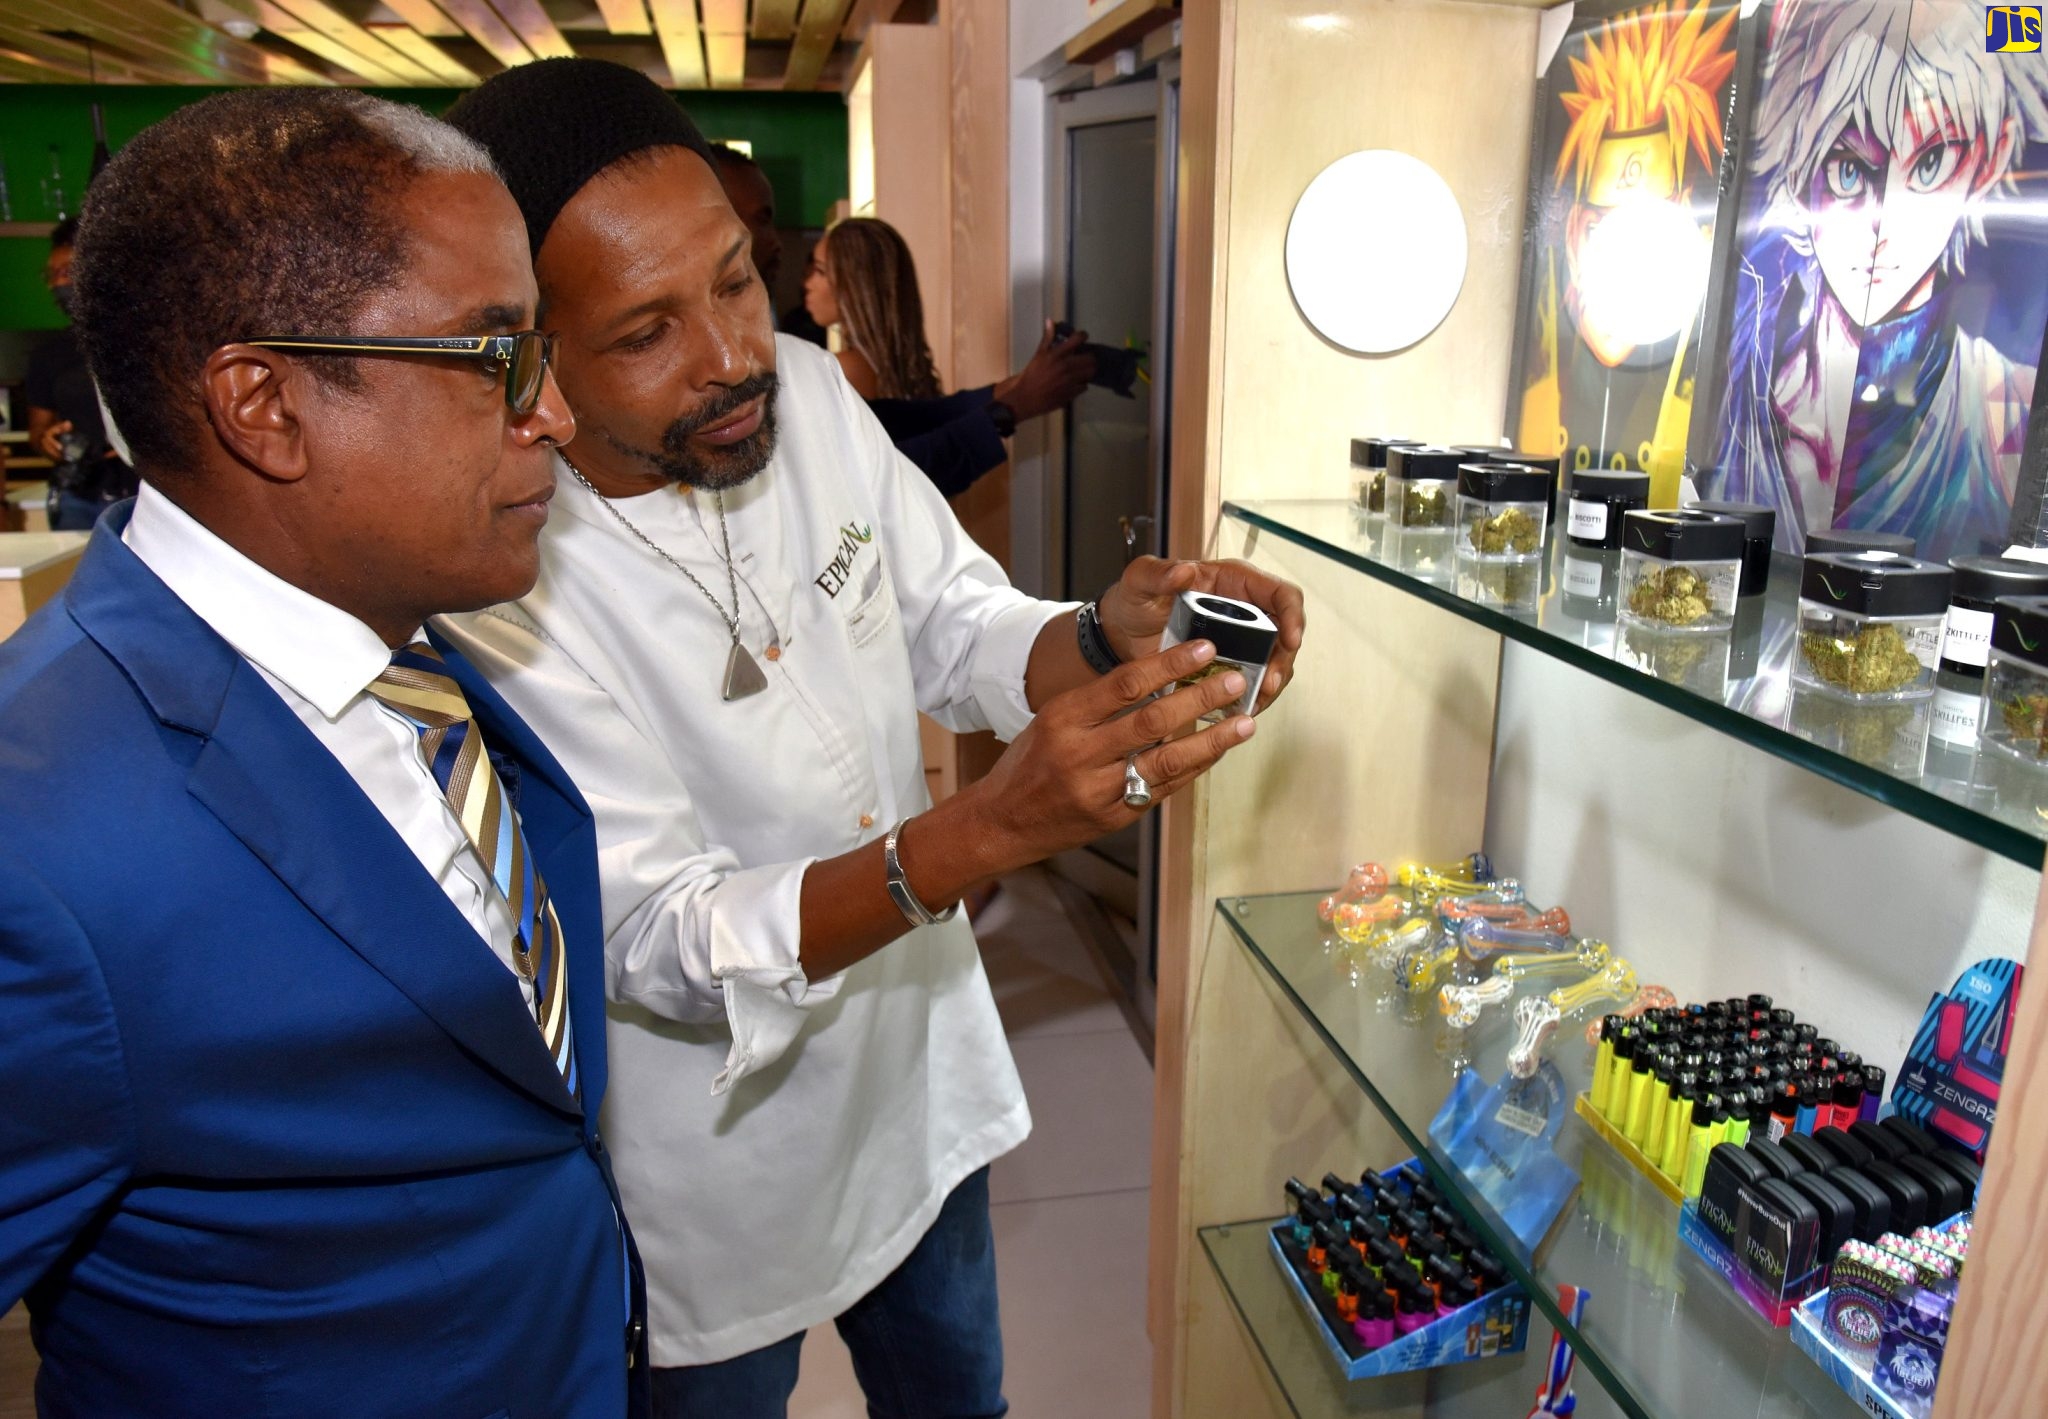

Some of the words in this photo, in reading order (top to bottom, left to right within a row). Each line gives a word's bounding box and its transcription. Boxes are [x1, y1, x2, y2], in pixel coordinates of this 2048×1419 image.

[814, 521, 871, 599] EPICAN
[1969, 976, 1992, 995] ISO
[1933, 1081, 1997, 1125] ZENGAZ
[1701, 1195, 1733, 1229] EPICAN
[1684, 1226, 1733, 1278] ZENGAZ
[1746, 1236, 1780, 1270] EPICAN
[1846, 1321, 1869, 1337] BLUE
[1865, 1393, 1894, 1419] SPE
